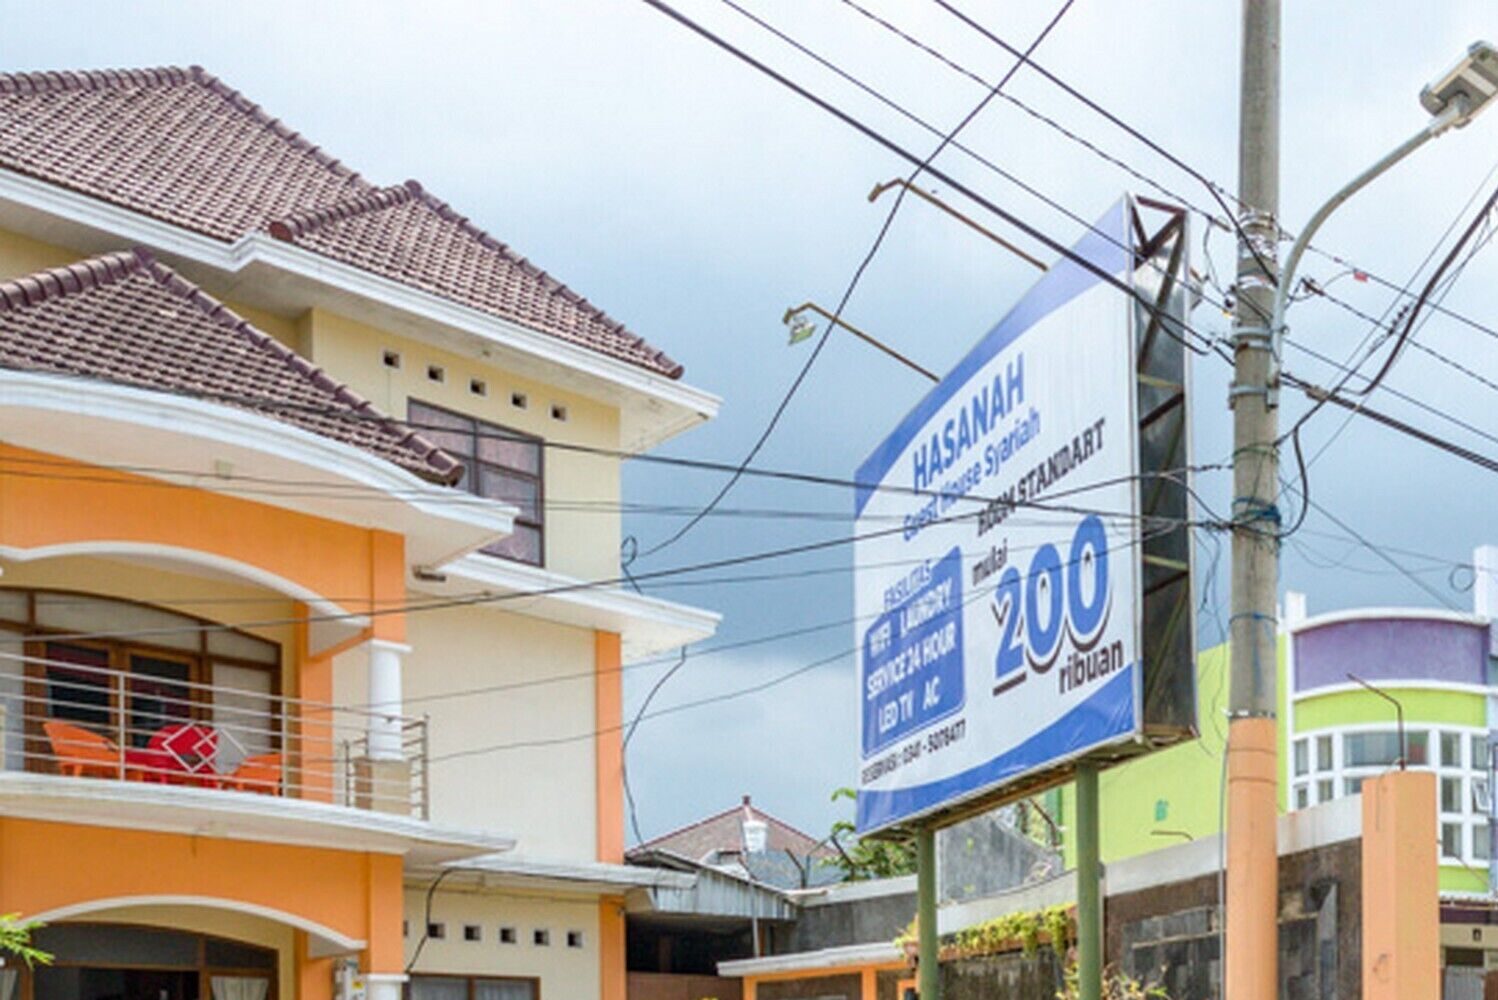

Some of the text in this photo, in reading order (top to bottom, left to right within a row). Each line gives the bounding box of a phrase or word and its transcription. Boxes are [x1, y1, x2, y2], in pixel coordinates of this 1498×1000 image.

[913, 351, 1025, 495] HASANAH
[940, 461, 982, 513] House
[984, 405, 1041, 477] Syariah
[1017, 416, 1106, 506] STANDART
[972, 537, 1008, 587] mulai
[995, 513, 1109, 680] 200
[866, 620, 956, 701] SERVICE 24 HOUR
[1059, 639, 1124, 694] ribuan
[878, 674, 942, 735] LED TV AC
